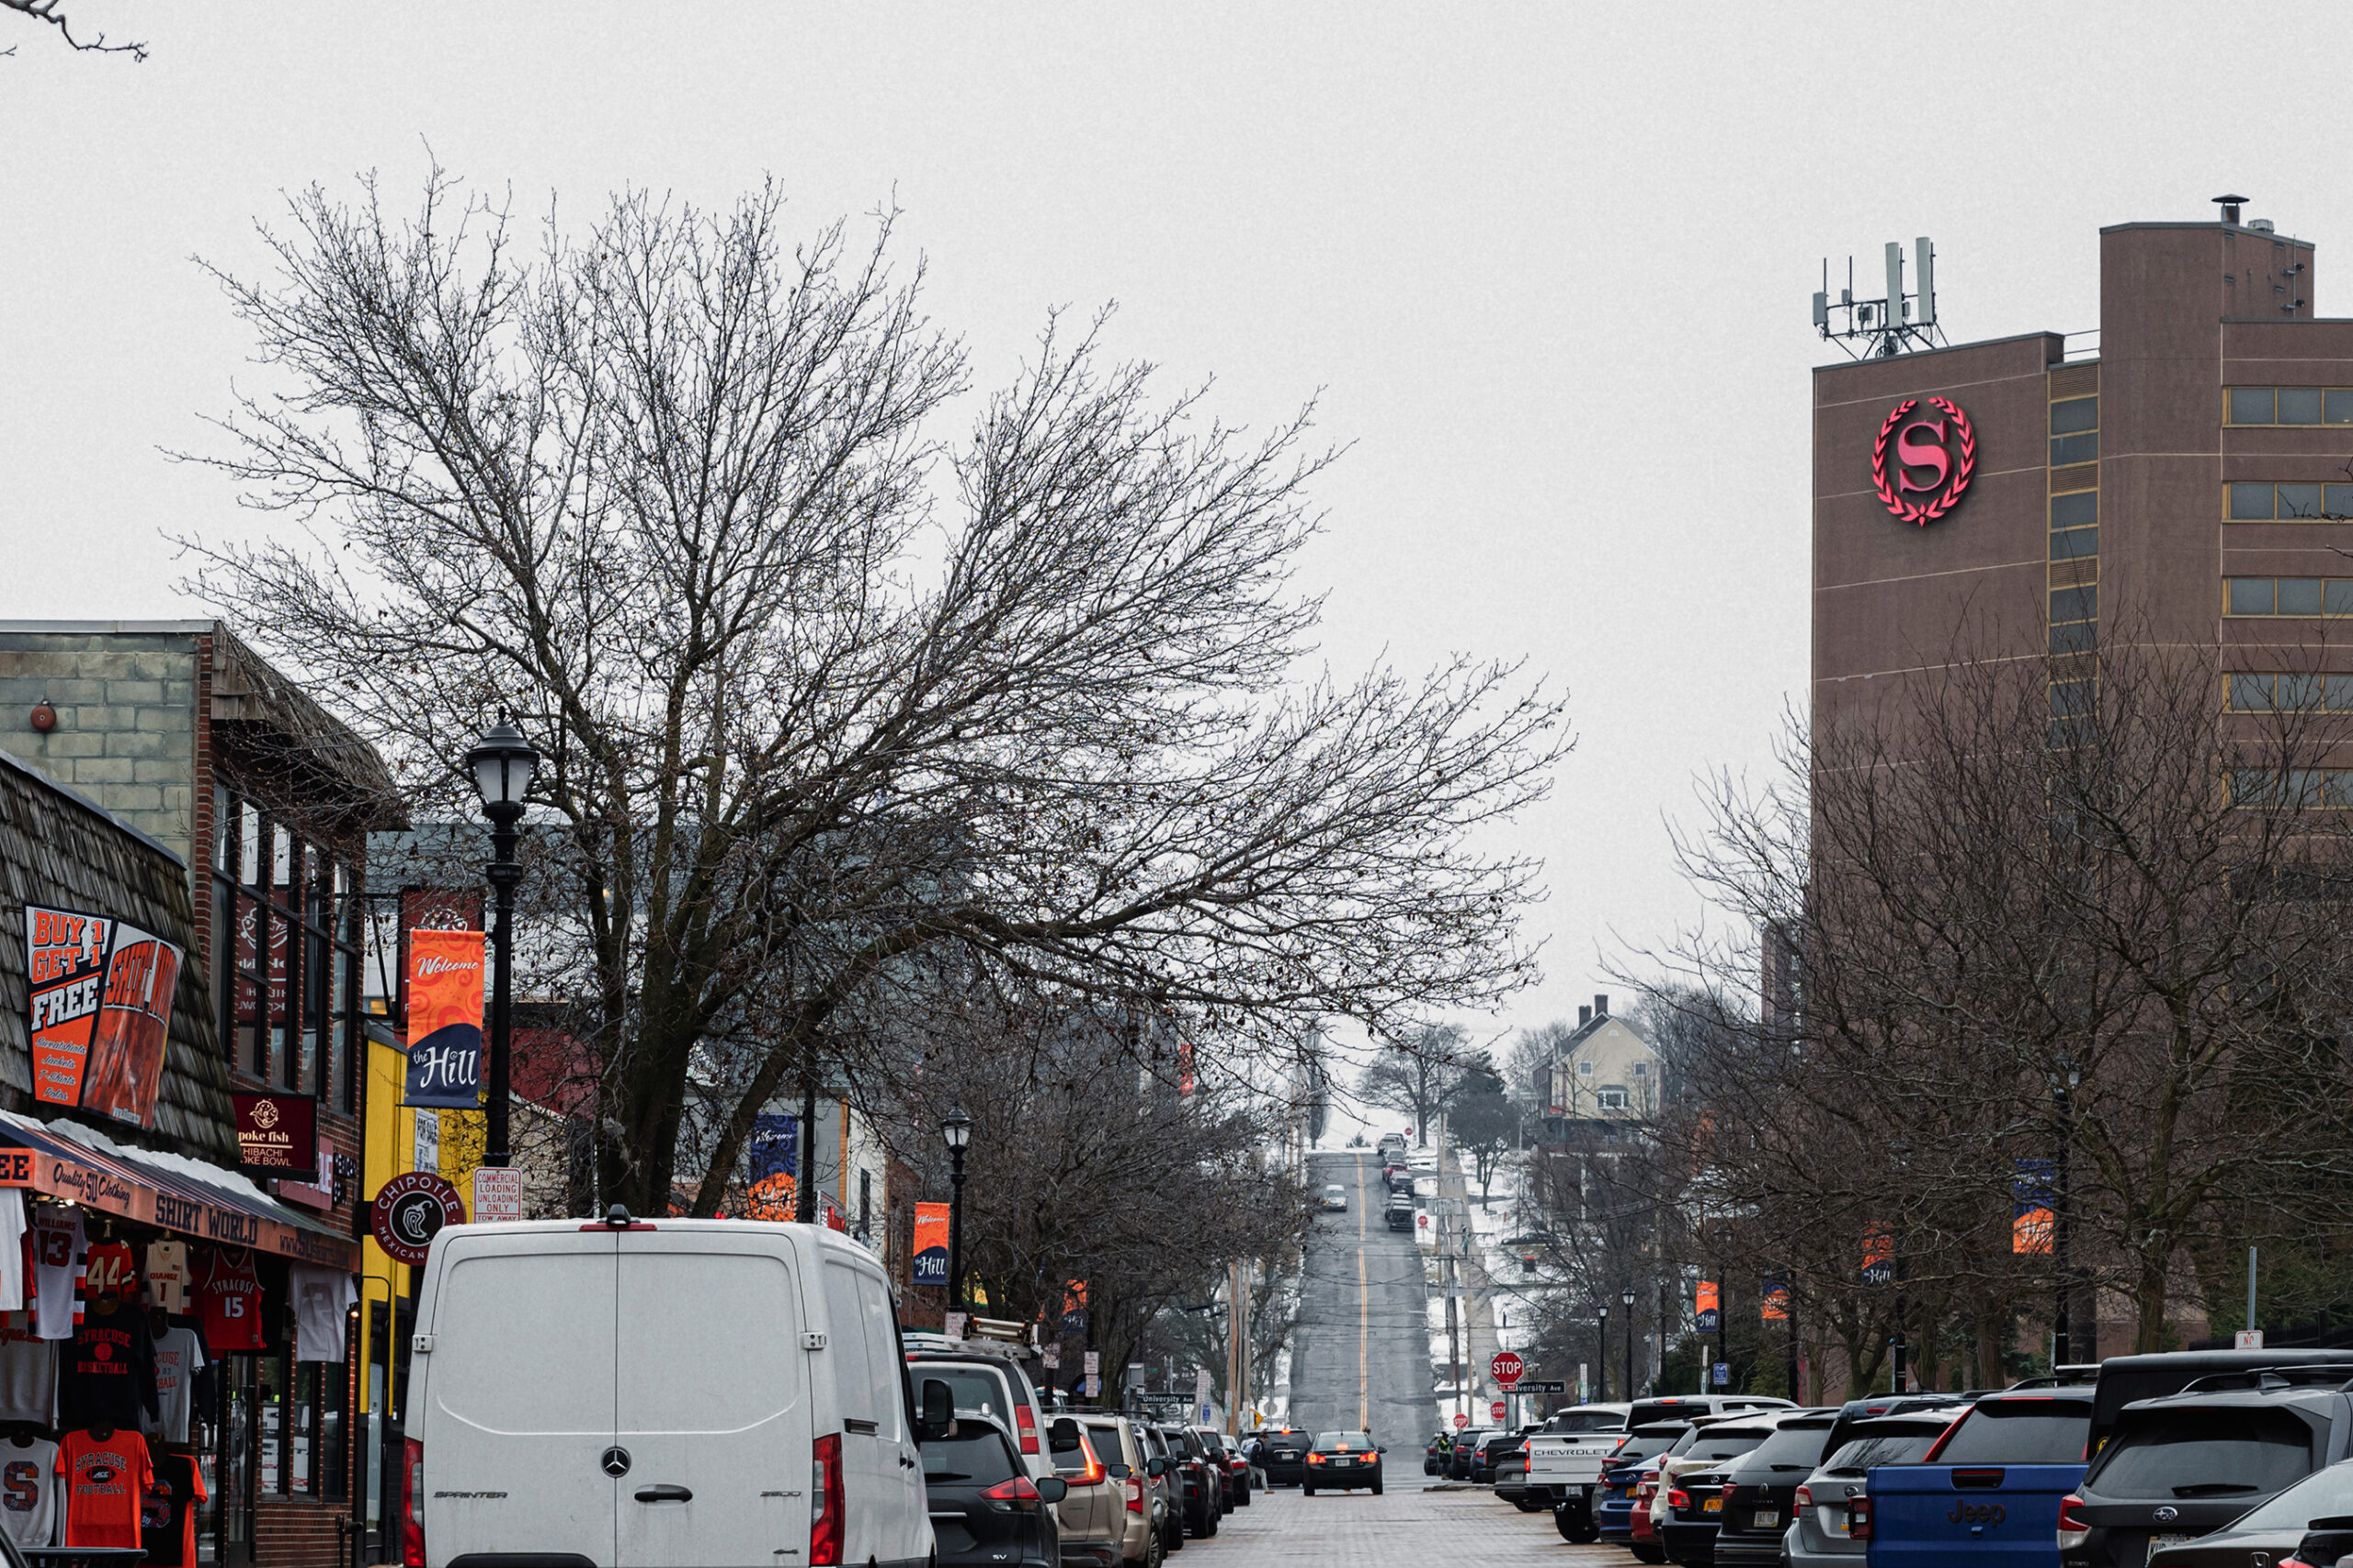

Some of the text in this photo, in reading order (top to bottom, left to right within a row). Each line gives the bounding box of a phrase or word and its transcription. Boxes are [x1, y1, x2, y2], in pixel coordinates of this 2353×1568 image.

[1897, 419, 1953, 493] S
[32, 909, 105, 947] BUY 1
[31, 944, 102, 984] GET 1
[416, 956, 479, 978] Welcome
[31, 976, 99, 1031] FREE
[35, 1036, 87, 1055] Sweatshirts
[40, 1054, 76, 1069] Jackets
[413, 1046, 477, 1088] the Hill
[38, 1069, 76, 1085] T-Shirts
[238, 1131, 289, 1142] poke fish
[243, 1148, 283, 1157] HIBACHI
[244, 1156, 292, 1166] OKE BOWL
[53, 1163, 86, 1197] Quality
[98, 1176, 131, 1210] Clothing
[478, 1173, 518, 1184] COMMERCIAL
[378, 1176, 459, 1213] CHIPOTLE
[480, 1185, 517, 1193] LOADING
[478, 1195, 518, 1203] UNLOADING
[486, 1204, 509, 1212] ONLY
[39, 1217, 76, 1231] WILLIAMS
[155, 1195, 258, 1245] SHIRT WORLD
[39, 1229, 73, 1267] 13
[379, 1226, 425, 1259] MEXICAN
[918, 1256, 946, 1277] Hill
[87, 1256, 121, 1294] 44
[212, 1278, 256, 1295] SYRACUSE
[224, 1297, 244, 1318] 15
[77, 1360, 129, 1374] BASKETBALL
[154, 1351, 180, 1367] CUSE
[1493, 1361, 1522, 1375] STOP
[1517, 1383, 1546, 1392] versity
[1142, 1395, 1180, 1403] University
[1534, 1449, 1609, 1457] CHEVROLET
[75, 1451, 128, 1474] SYRACUSE
[92, 1471, 110, 1480] ACC
[75, 1483, 128, 1495] FOOTBALL
[434, 1491, 509, 1499] SPRINTER
[1948, 1498, 2006, 1528] Jeep
